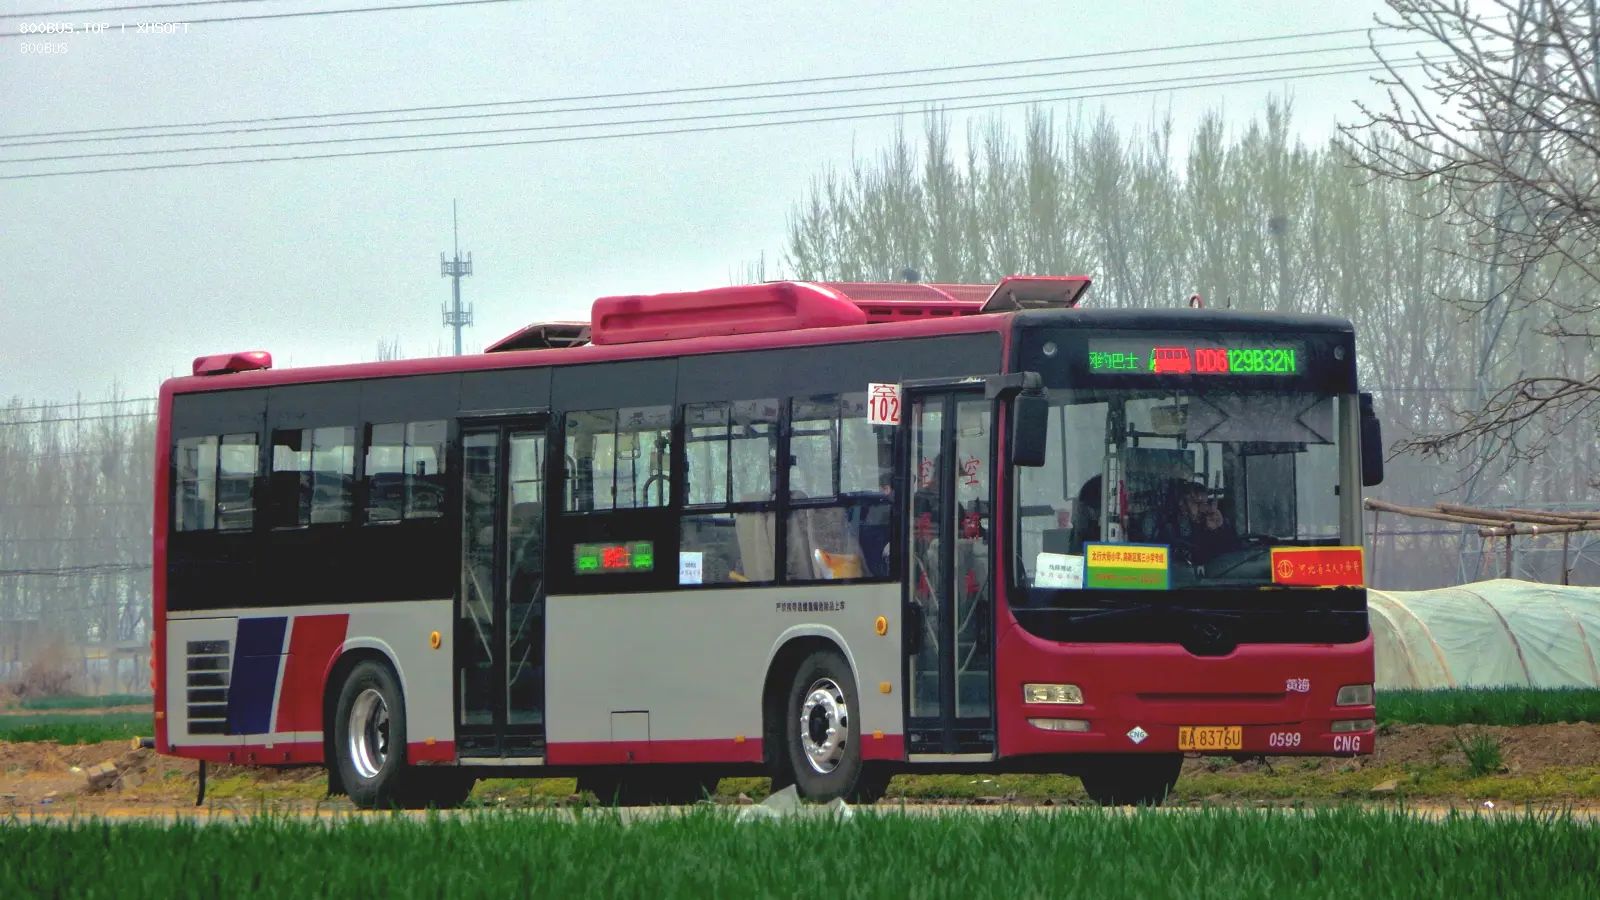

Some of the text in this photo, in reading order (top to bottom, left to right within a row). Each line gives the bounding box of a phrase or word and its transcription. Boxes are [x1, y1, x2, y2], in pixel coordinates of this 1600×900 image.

[869, 397, 899, 423] 102
[1269, 732, 1301, 747] 0599
[1333, 735, 1361, 751] CNG
